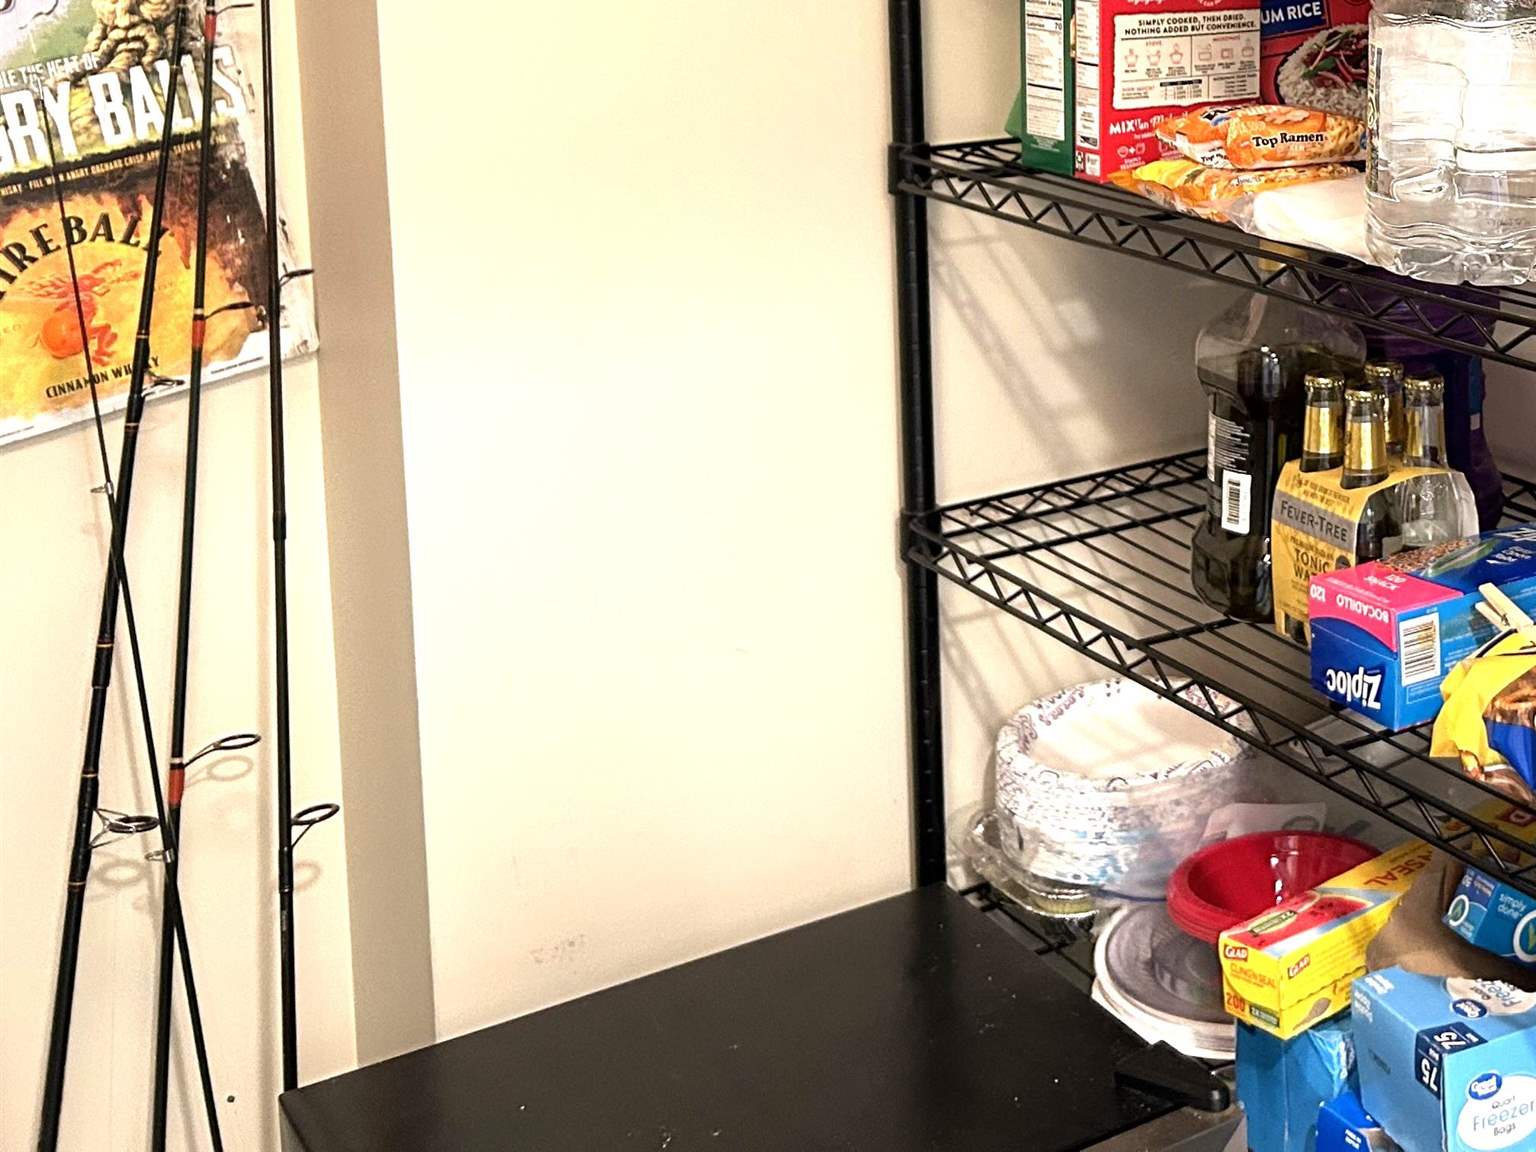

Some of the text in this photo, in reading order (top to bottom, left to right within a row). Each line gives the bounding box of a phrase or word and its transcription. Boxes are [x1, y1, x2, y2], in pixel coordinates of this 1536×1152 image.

[1138, 13, 1246, 27] SIMPLY COOKED, THEN DRIED.
[1287, 1, 1323, 19] RICE
[1054, 22, 1063, 30] 70
[1125, 20, 1256, 35] NOTHING ADDED BUT CONVENIENCE.
[81, 51, 101, 71] OF
[87, 46, 249, 147] BALLS
[1252, 132, 1324, 149] Top Ramen
[0, 211, 169, 300] IREBAL
[44, 369, 111, 400] CINNAMON
[1281, 501, 1348, 542] FEVER-TREE
[1295, 549, 1330, 573] TONIC
[1310, 584, 1389, 623] 120 BOCADILLO
[1326, 666, 1382, 710] Ziploc
[1499, 893, 1527, 911] simply
[1224, 946, 1248, 960] GLAD
[1288, 955, 1310, 978] GLAD
[1226, 992, 1245, 1012] 200
[1433, 1031, 1467, 1050] 75
[1420, 1058, 1439, 1092] 75
[1491, 1096, 1516, 1110] Quart
[1473, 1100, 1536, 1132] Freezer
[1493, 1122, 1516, 1137] Bags
